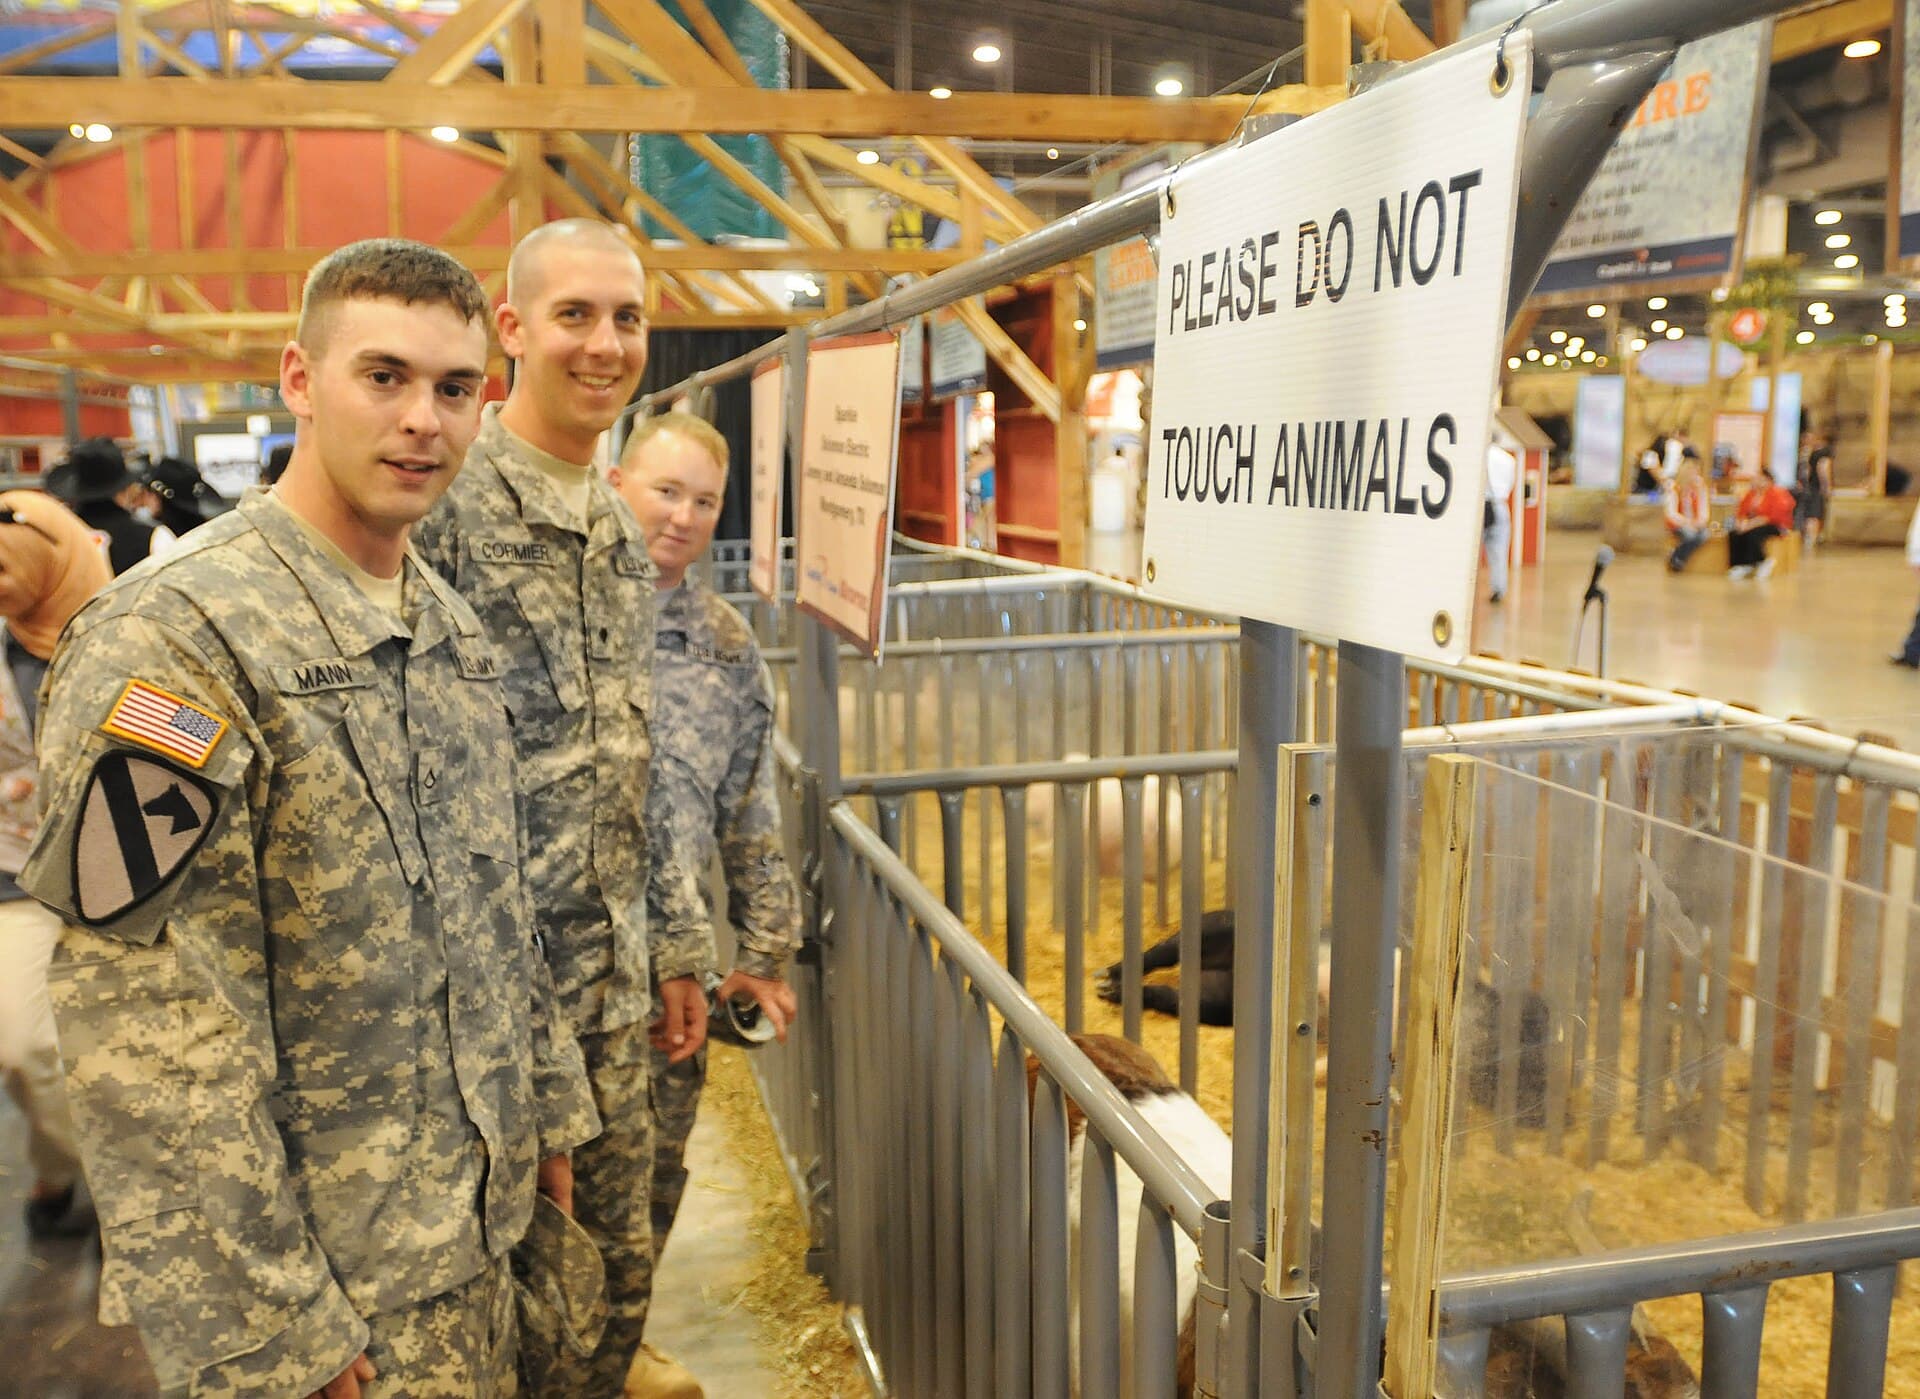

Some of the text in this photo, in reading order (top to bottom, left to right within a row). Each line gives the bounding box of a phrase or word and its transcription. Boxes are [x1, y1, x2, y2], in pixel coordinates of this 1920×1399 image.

[1622, 70, 1712, 131] IRE
[1170, 230, 1280, 335] PLEASE
[1295, 207, 1354, 308] DO
[1373, 168, 1483, 292] NOT
[1163, 412, 1458, 520] TOUCH ANIMALS
[481, 542, 550, 562] CORMIER
[293, 663, 353, 689] MANN
